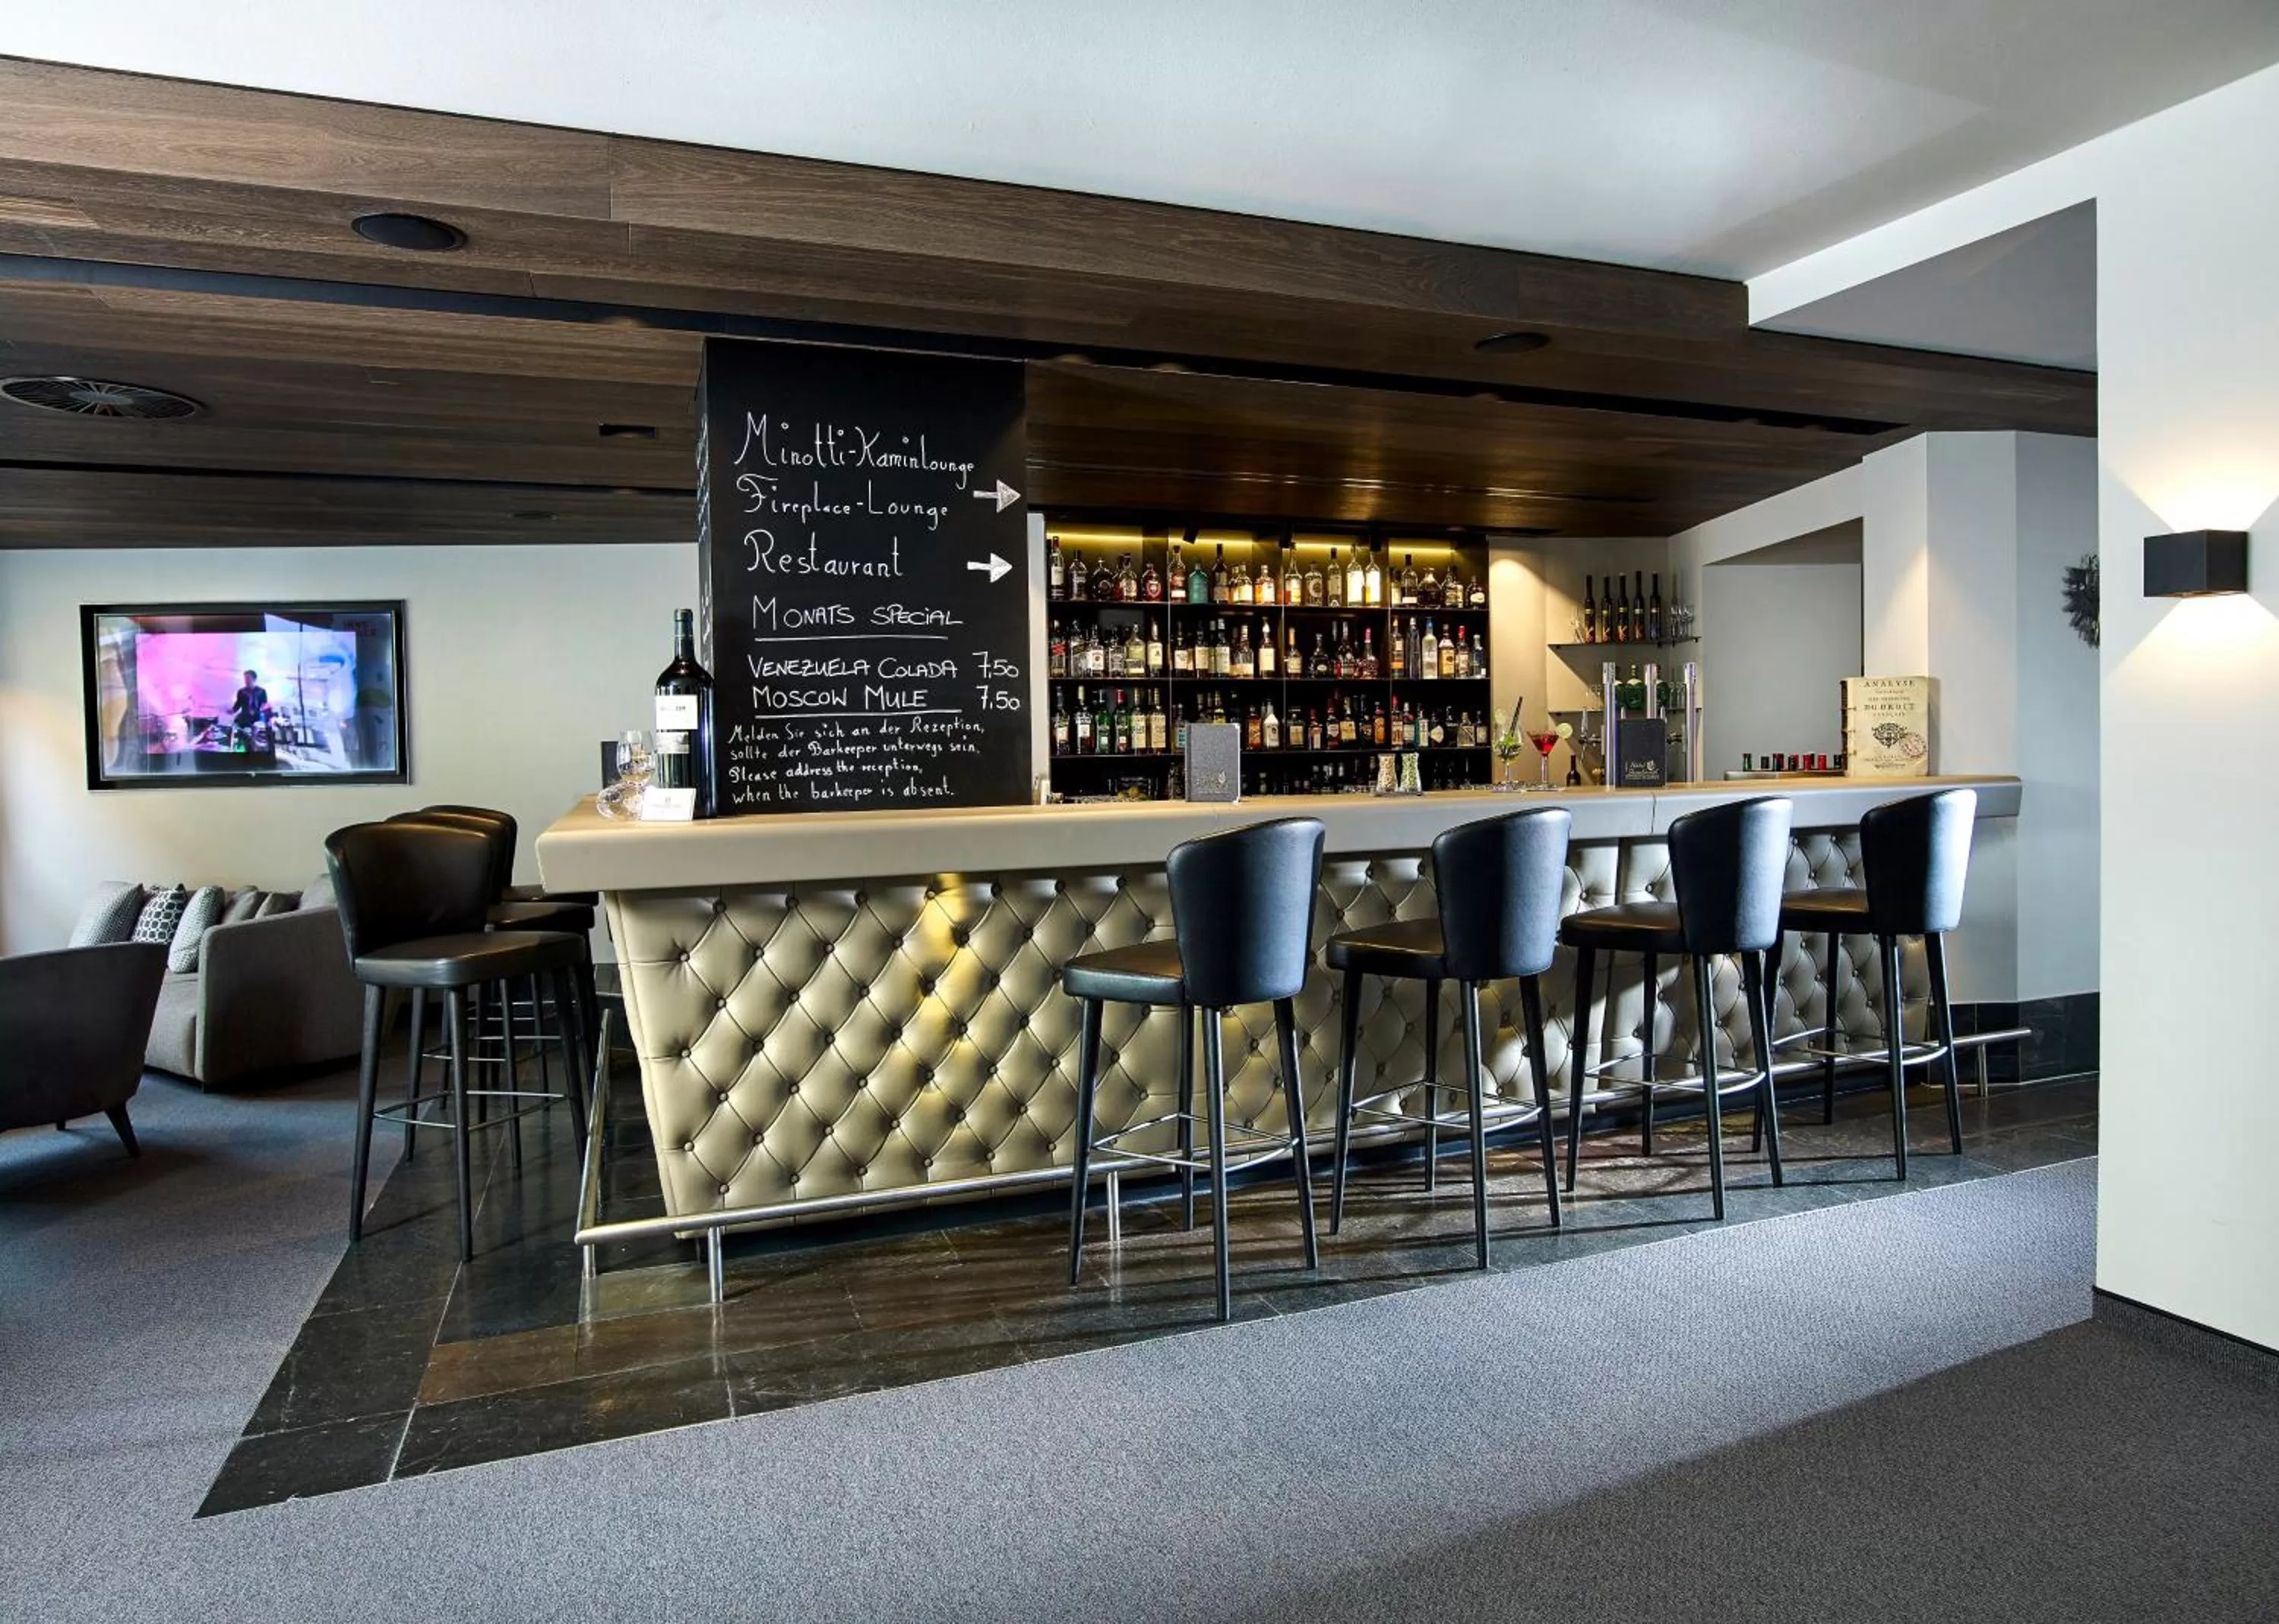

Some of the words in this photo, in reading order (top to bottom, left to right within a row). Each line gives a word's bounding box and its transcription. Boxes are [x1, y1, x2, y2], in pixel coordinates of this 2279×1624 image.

[736, 473, 949, 530] Fireplace-Lounge
[744, 529, 903, 577] Restaurant
[752, 595, 855, 630] MONATS
[747, 654, 871, 678] VENEZUELA
[877, 657, 958, 678] COLADA
[752, 685, 848, 709] MOSCOW
[865, 684, 929, 710] MULE
[728, 724, 779, 744] Melden
[785, 722, 805, 740] Sie
[814, 720, 846, 738] sich
[852, 725, 871, 736] an
[879, 719, 901, 735] der
[730, 745, 768, 760] sollte
[777, 744, 801, 758] der
[808, 739, 877, 759] Barkeeper
[883, 736, 943, 758] unterwegs
[729, 766, 778, 783] Please
[785, 762, 833, 777] address
[836, 759, 855, 773] the
[732, 785, 772, 804] when
[779, 783, 798, 800] the
[811, 780, 873, 801] barkeeper
[881, 778, 894, 796] is
[903, 775, 955, 796] absent.
